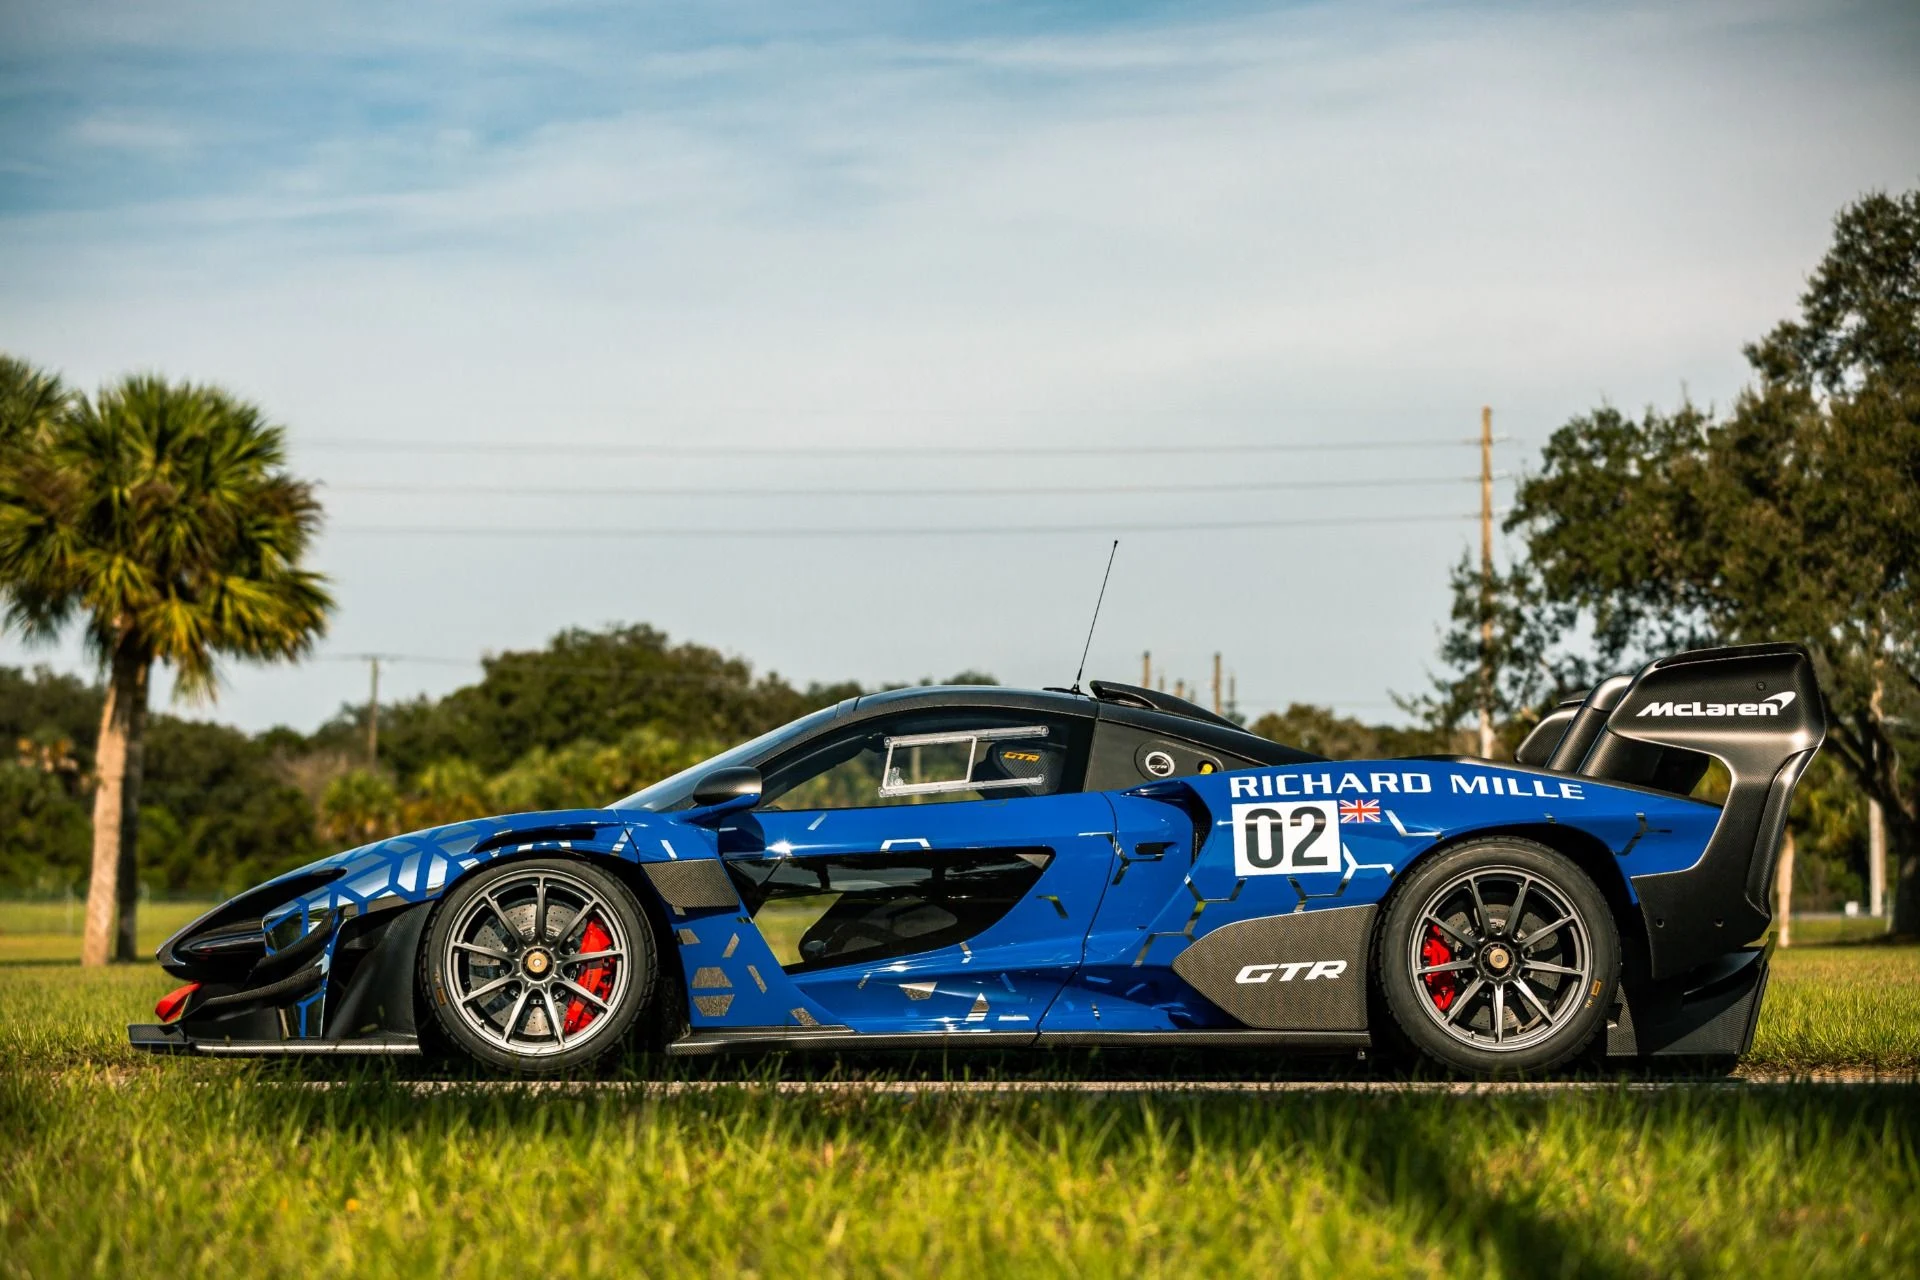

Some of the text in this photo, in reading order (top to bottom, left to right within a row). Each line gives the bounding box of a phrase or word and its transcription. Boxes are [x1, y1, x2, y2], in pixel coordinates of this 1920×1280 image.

[1636, 701, 1779, 717] McLaren
[1003, 751, 1041, 763] GTR
[1230, 772, 1585, 800] RICHARD MILLE
[1244, 806, 1328, 869] 02
[1235, 959, 1347, 984] GTR
